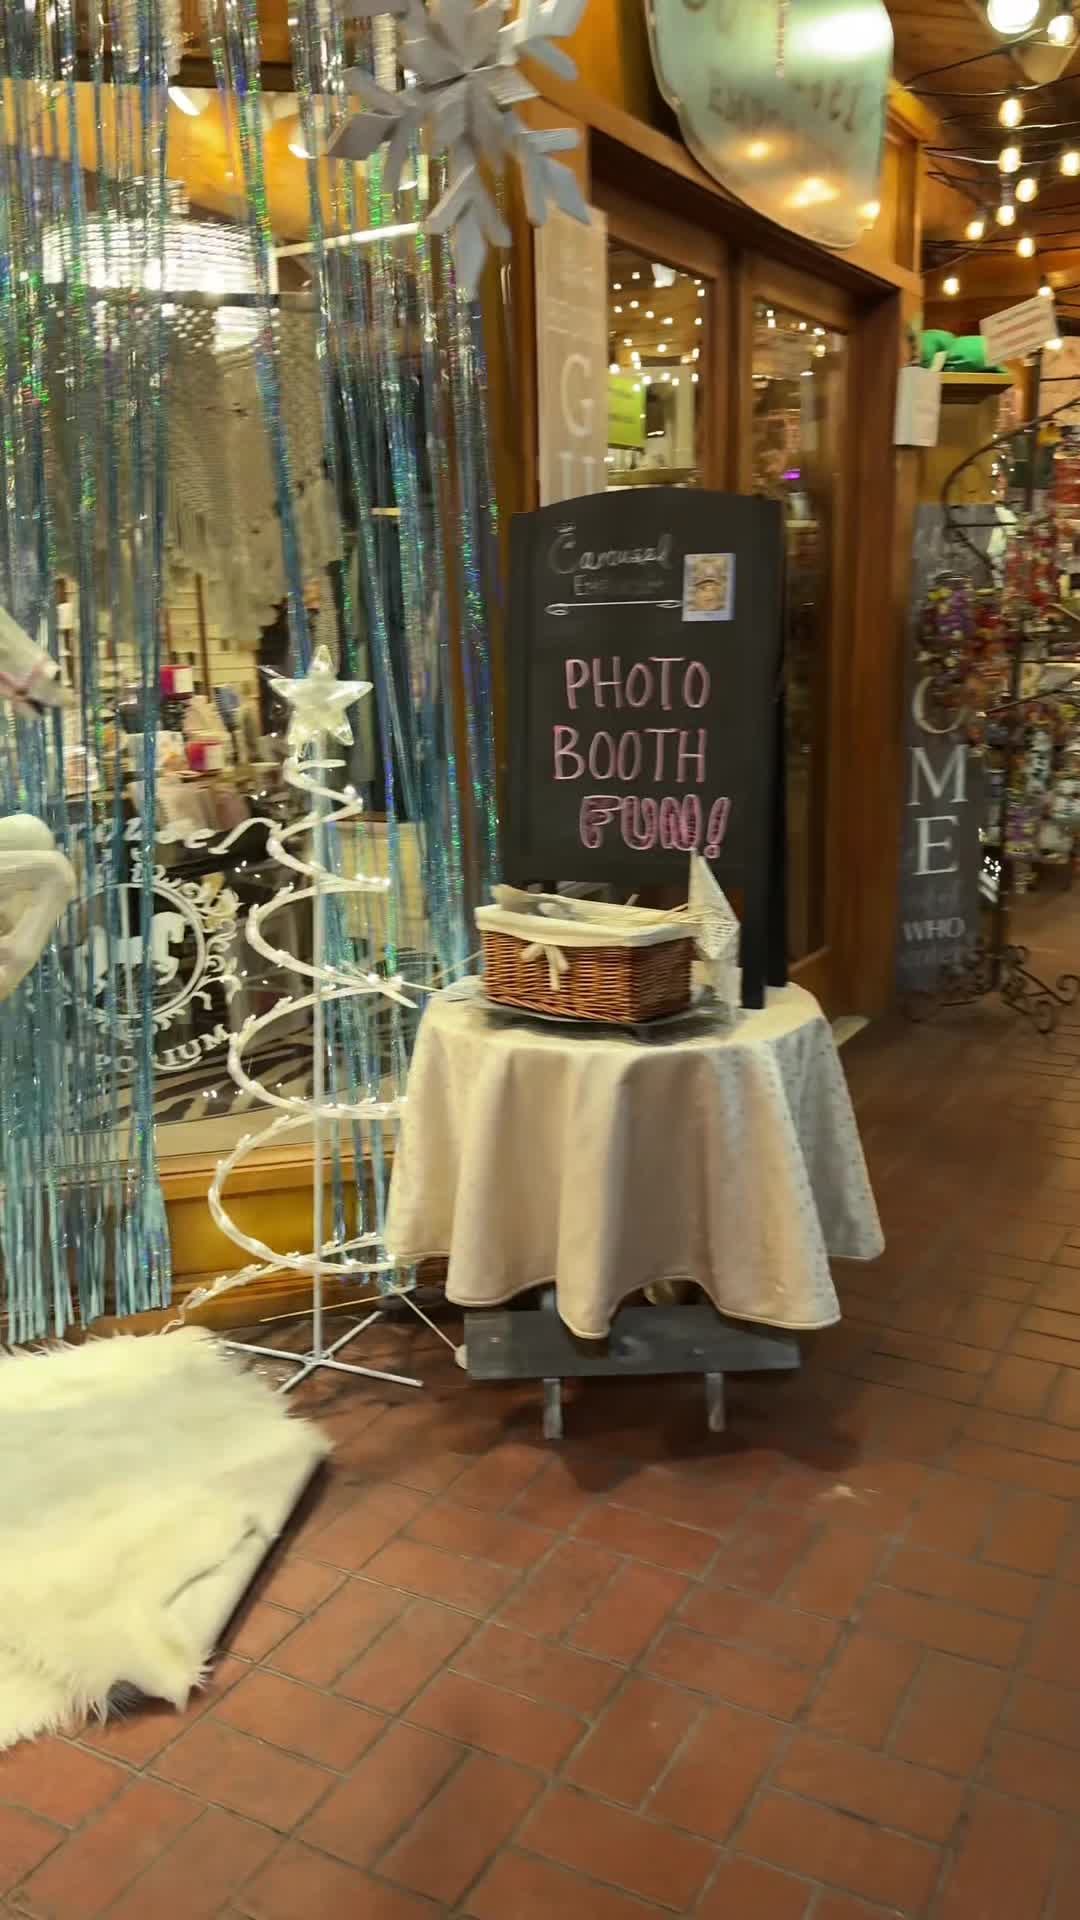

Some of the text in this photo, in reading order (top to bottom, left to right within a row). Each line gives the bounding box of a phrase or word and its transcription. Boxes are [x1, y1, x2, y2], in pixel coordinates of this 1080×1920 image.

[565, 655, 711, 711] PHOTO
[553, 724, 708, 784] BOOTH
[579, 794, 731, 859] FUN!
[903, 916, 967, 942] WHO
